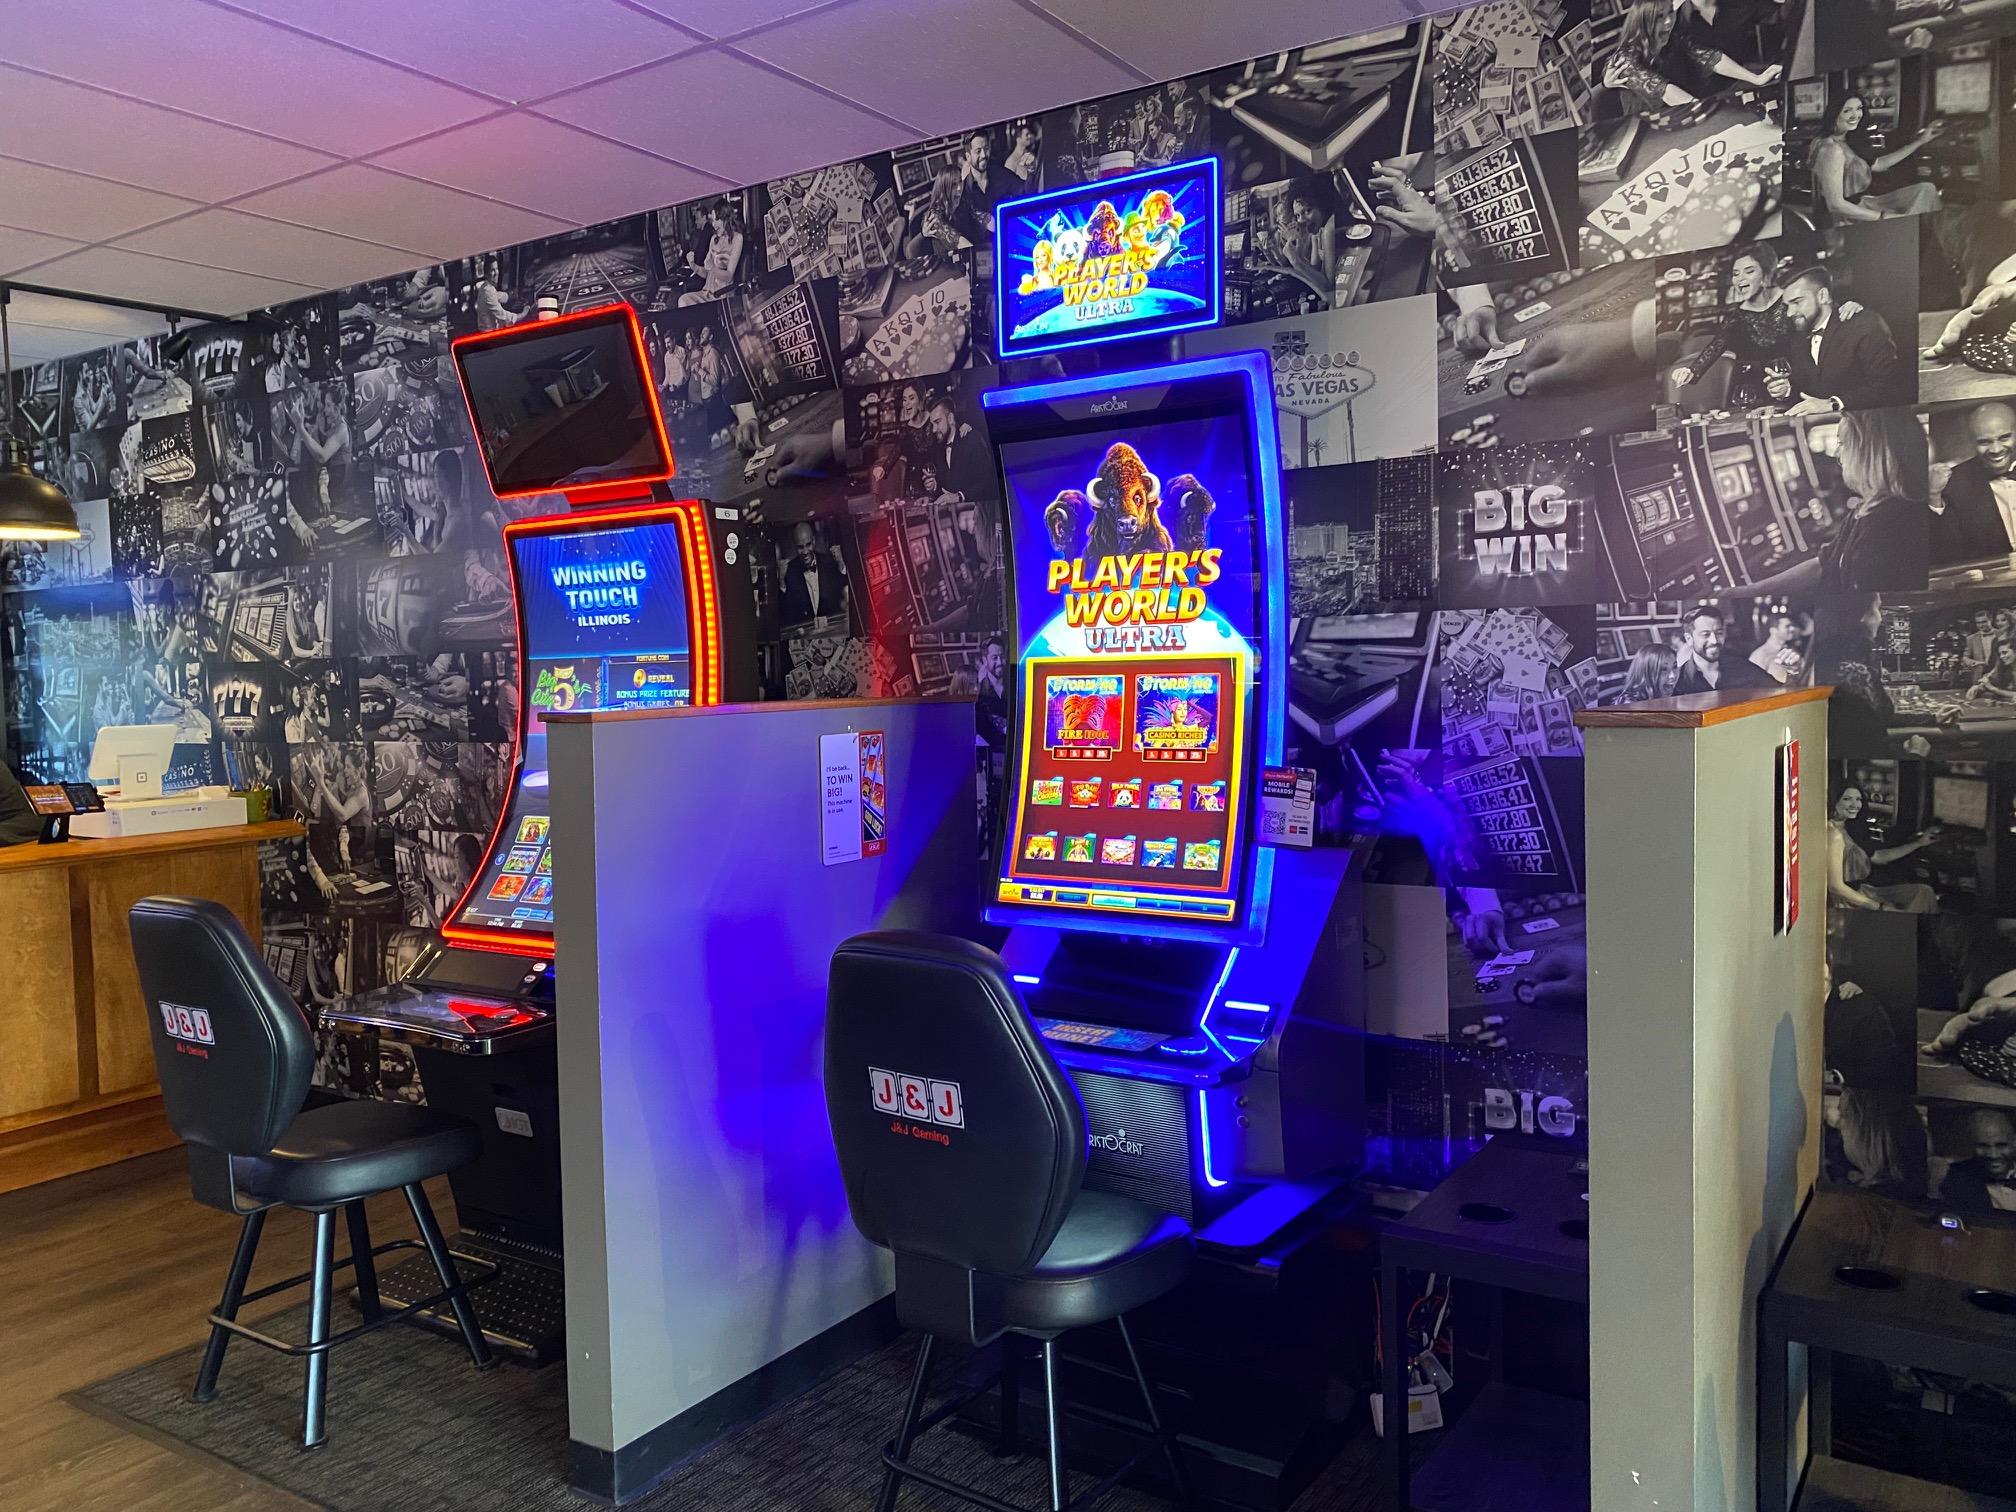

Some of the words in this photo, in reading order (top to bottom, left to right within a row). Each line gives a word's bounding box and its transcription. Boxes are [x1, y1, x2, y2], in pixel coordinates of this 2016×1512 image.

[1600, 207, 1623, 226] A
[1618, 184, 1643, 206] K
[1644, 171, 1670, 190] Q
[1672, 154, 1690, 175] J
[1703, 140, 1727, 161] 10
[1472, 193, 1523, 224] $377.80
[1481, 215, 1532, 243] $177.30
[1053, 248, 1159, 286] PLAYER'S
[931, 290, 945, 306] 10
[1062, 272, 1149, 306] WORLD
[1074, 298, 1136, 321] ULTRA
[195, 338, 243, 381] 777
[1287, 370, 1346, 382] Fabulous
[1302, 378, 1359, 396] VEGAS
[1291, 398, 1330, 406] NEVADA
[144, 438, 175, 461] CASINO
[1474, 484, 1568, 534] BIG
[1473, 532, 1568, 576] WIN
[551, 560, 647, 588] WINNING
[1047, 548, 1223, 593] PLAYER'S
[565, 586, 639, 611] TOUCH
[1064, 586, 1207, 628] WORLD
[577, 613, 631, 627] ILLINOIS
[1084, 624, 1187, 654] ULTRA
[213, 680, 262, 717] 777
[616, 690, 638, 699] BONUS
[639, 689, 657, 698] PRIZE
[660, 688, 690, 698] FEATURE
[1058, 729, 1083, 740] FIRE
[1084, 729, 1110, 740] IDOL
[1149, 731, 1177, 740] CASINO
[164, 767, 195, 782] CASINO
[826, 775, 836, 786] TO
[837, 773, 853, 784] WIN
[1267, 780, 1291, 788] MOBILE
[827, 787, 843, 798] BIG!
[1263, 787, 1294, 795] REWARDS!
[1504, 854, 1543, 872] 47.47
[1041, 1030, 1105, 1044] MONEY
[1052, 1024, 1116, 1037] INSERT
[1485, 1087, 1575, 1137] BIG
[912, 1126, 950, 1146] Gaming
[1089, 1129, 1144, 1156] RISTOCRAT
